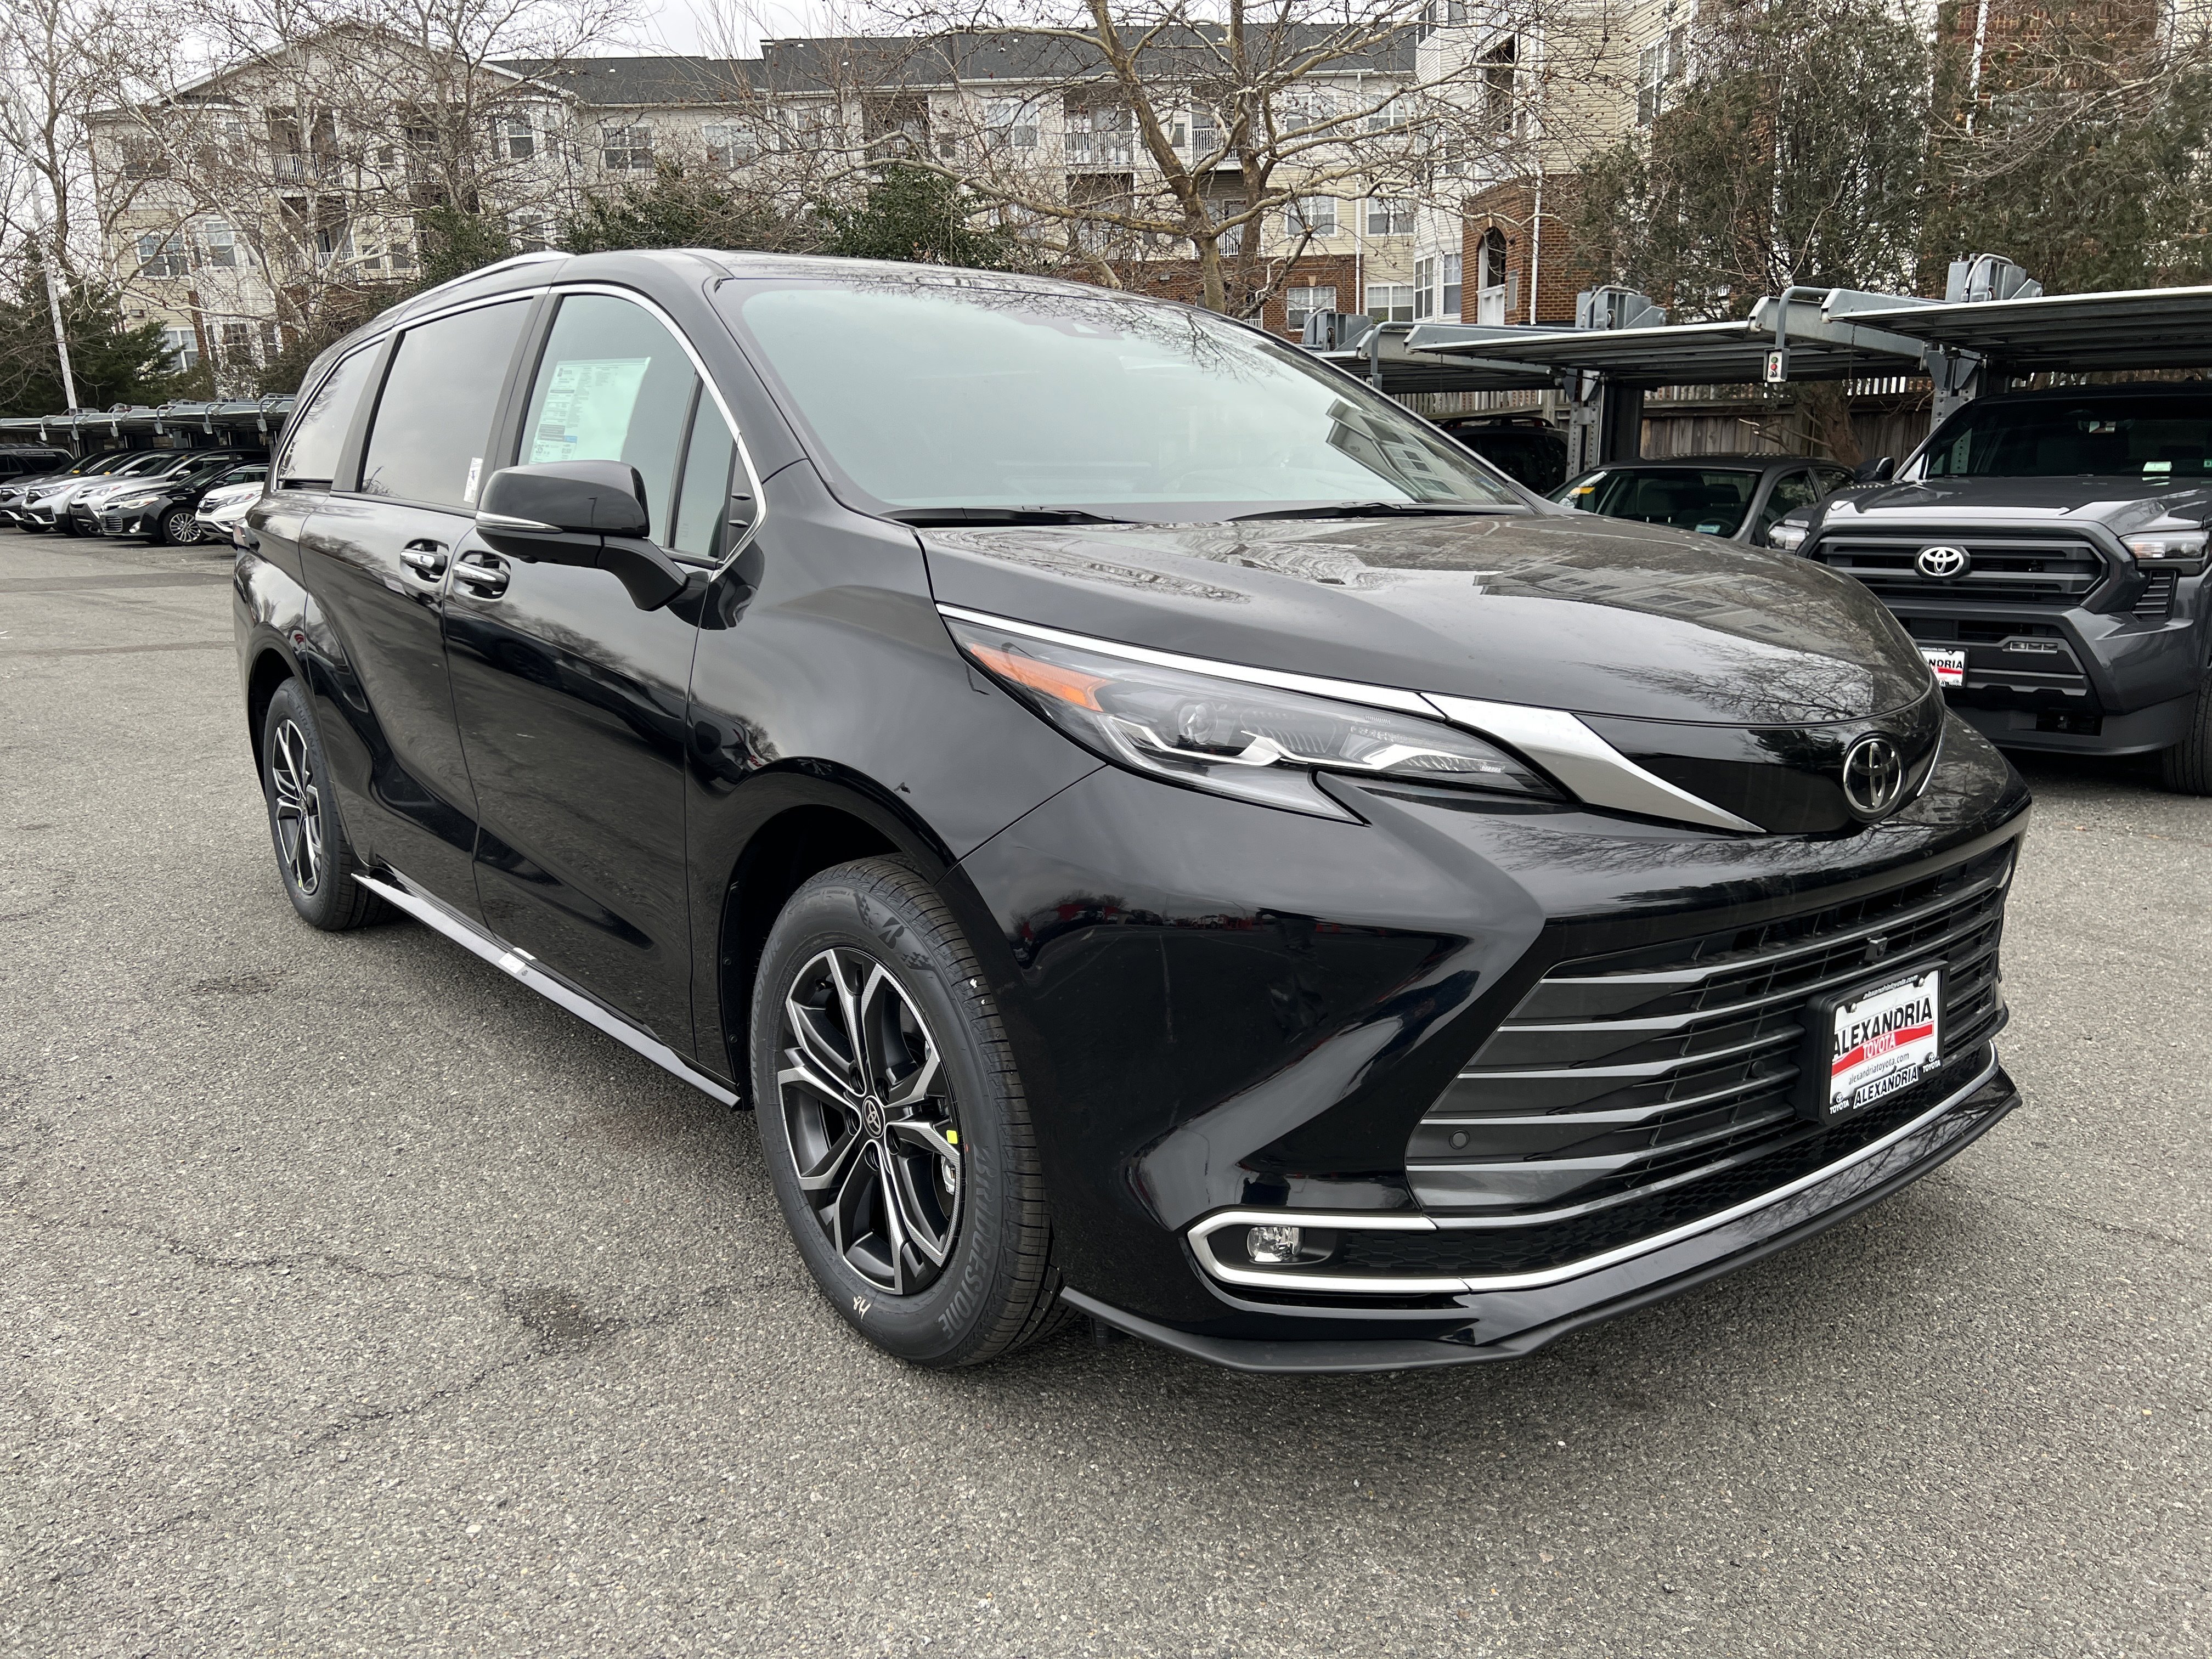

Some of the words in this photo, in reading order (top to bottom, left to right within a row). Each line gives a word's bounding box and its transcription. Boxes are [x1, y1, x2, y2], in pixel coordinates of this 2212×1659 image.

[1834, 997, 1932, 1057] ALEXANDRIA
[1863, 1032, 1896, 1059] TOYOTA
[1848, 1053, 1909, 1085] alexandriatoyota.com
[1923, 1060, 1941, 1073] TOYOTA
[1854, 1066, 1917, 1107] ALEXANDRIA
[1830, 1099, 1849, 1114] TOYOTA
[938, 1143, 998, 1340] BRIDGESTONE
